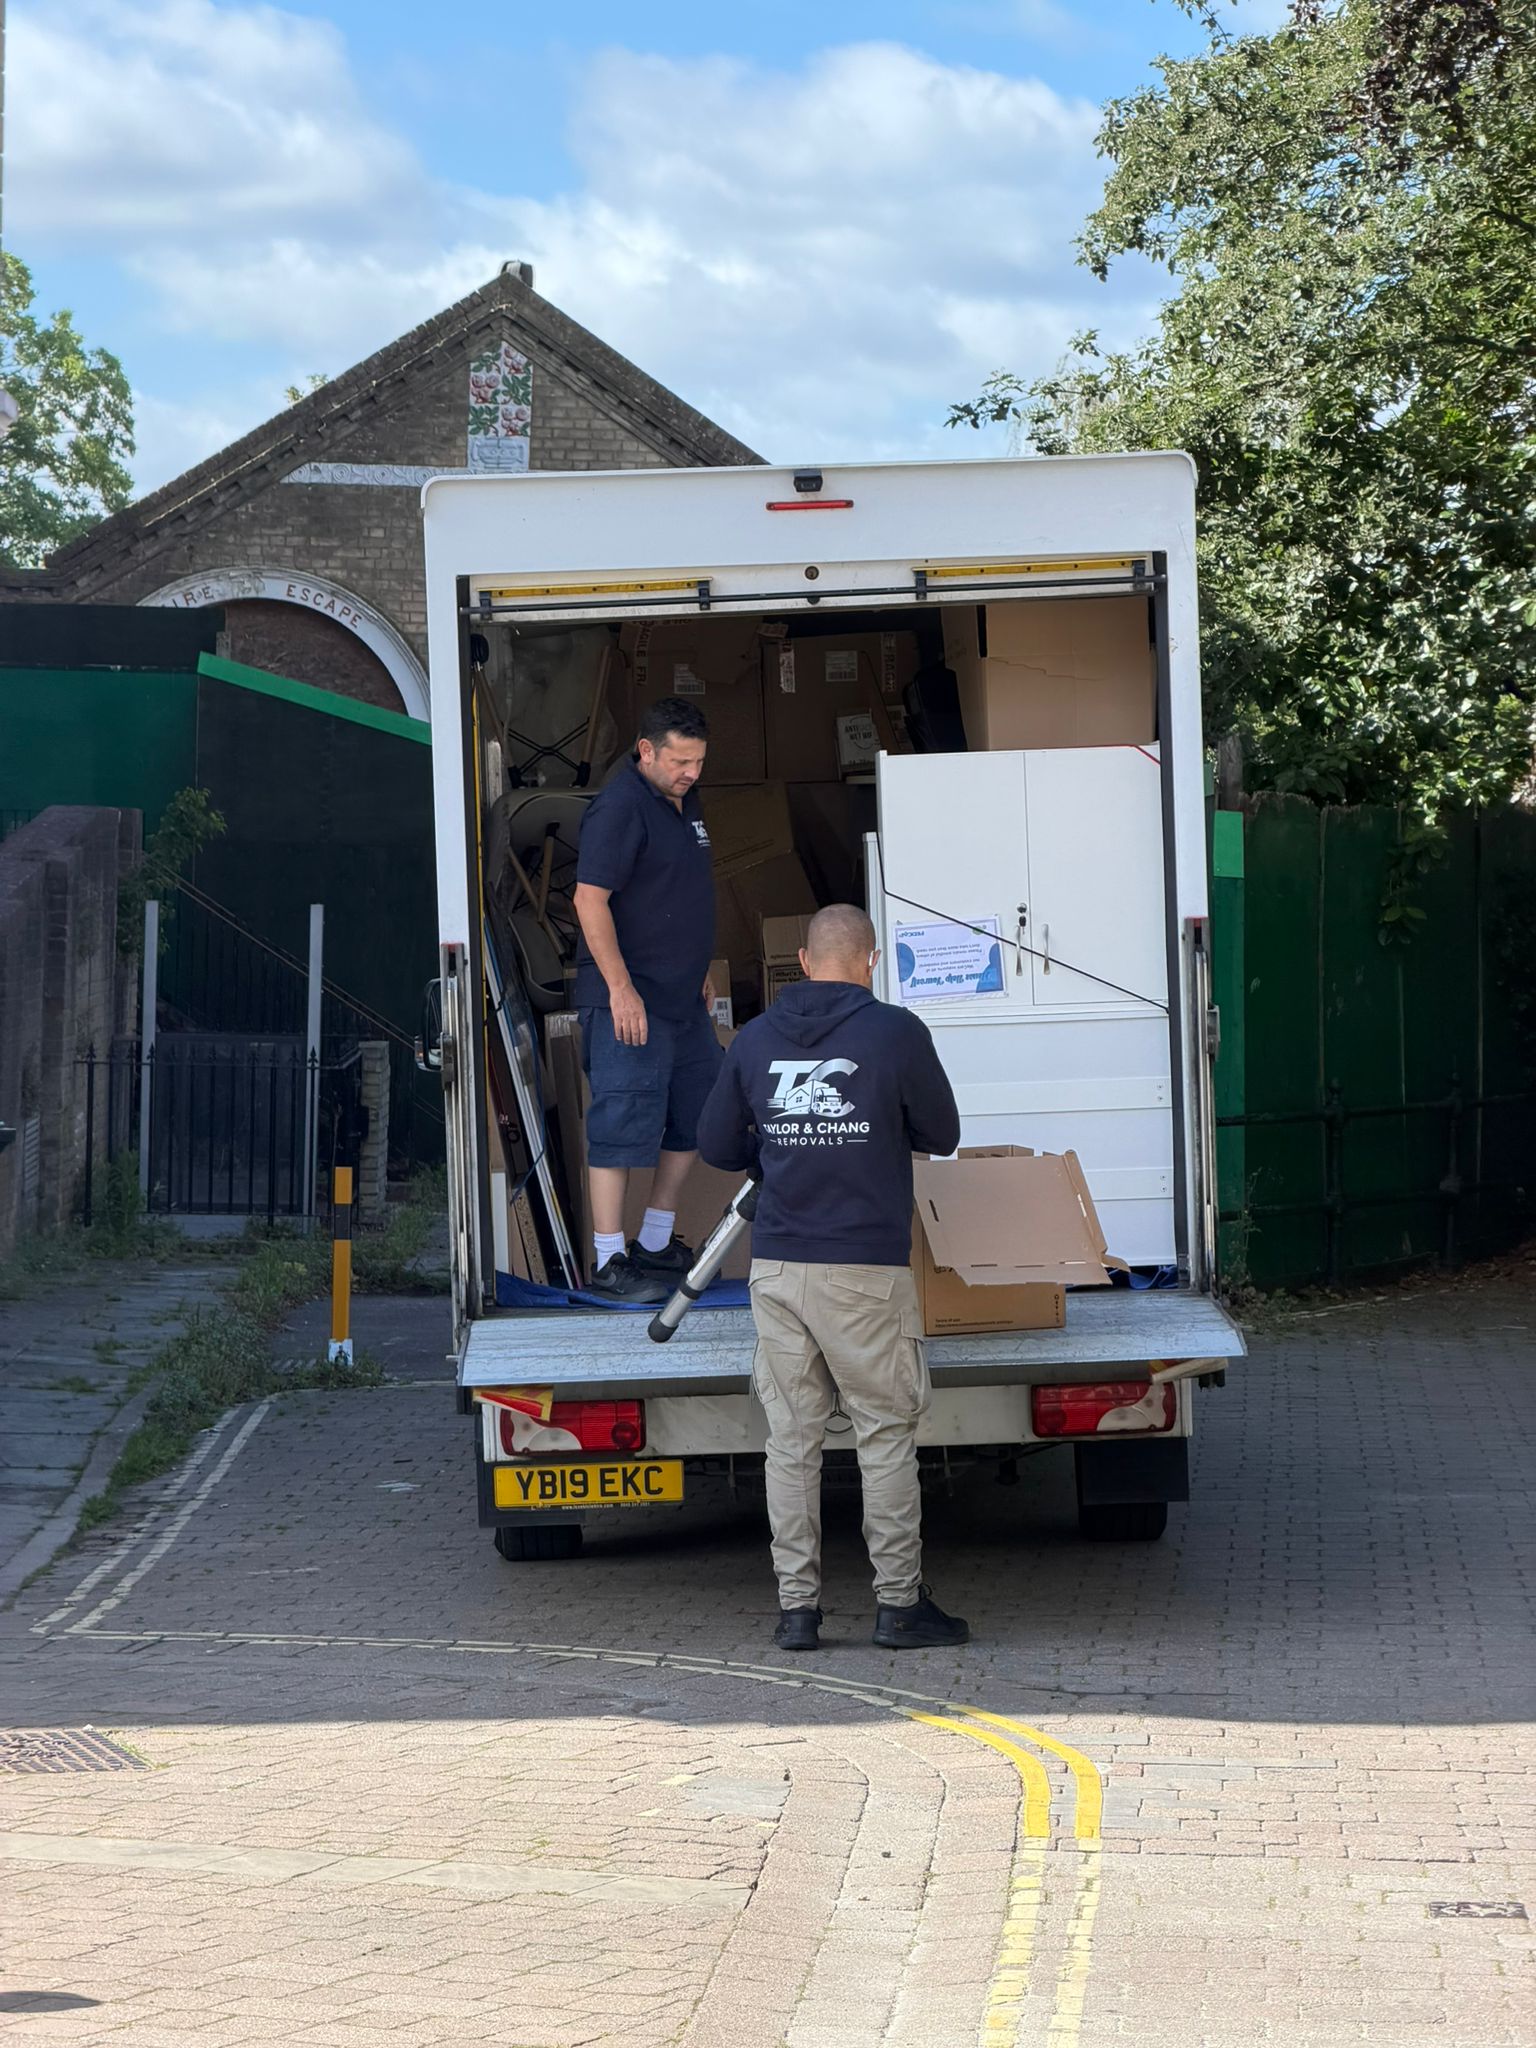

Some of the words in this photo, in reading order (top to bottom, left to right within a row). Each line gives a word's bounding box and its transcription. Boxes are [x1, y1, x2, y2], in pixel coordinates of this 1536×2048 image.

[162, 586, 216, 609] IRE
[287, 583, 363, 629] ESCAPE
[803, 1122, 813, 1134] &
[816, 1121, 870, 1134] CHANG
[777, 1136, 843, 1146] REMOVALS
[515, 1468, 589, 1500] YB19
[600, 1465, 663, 1497] EKC
